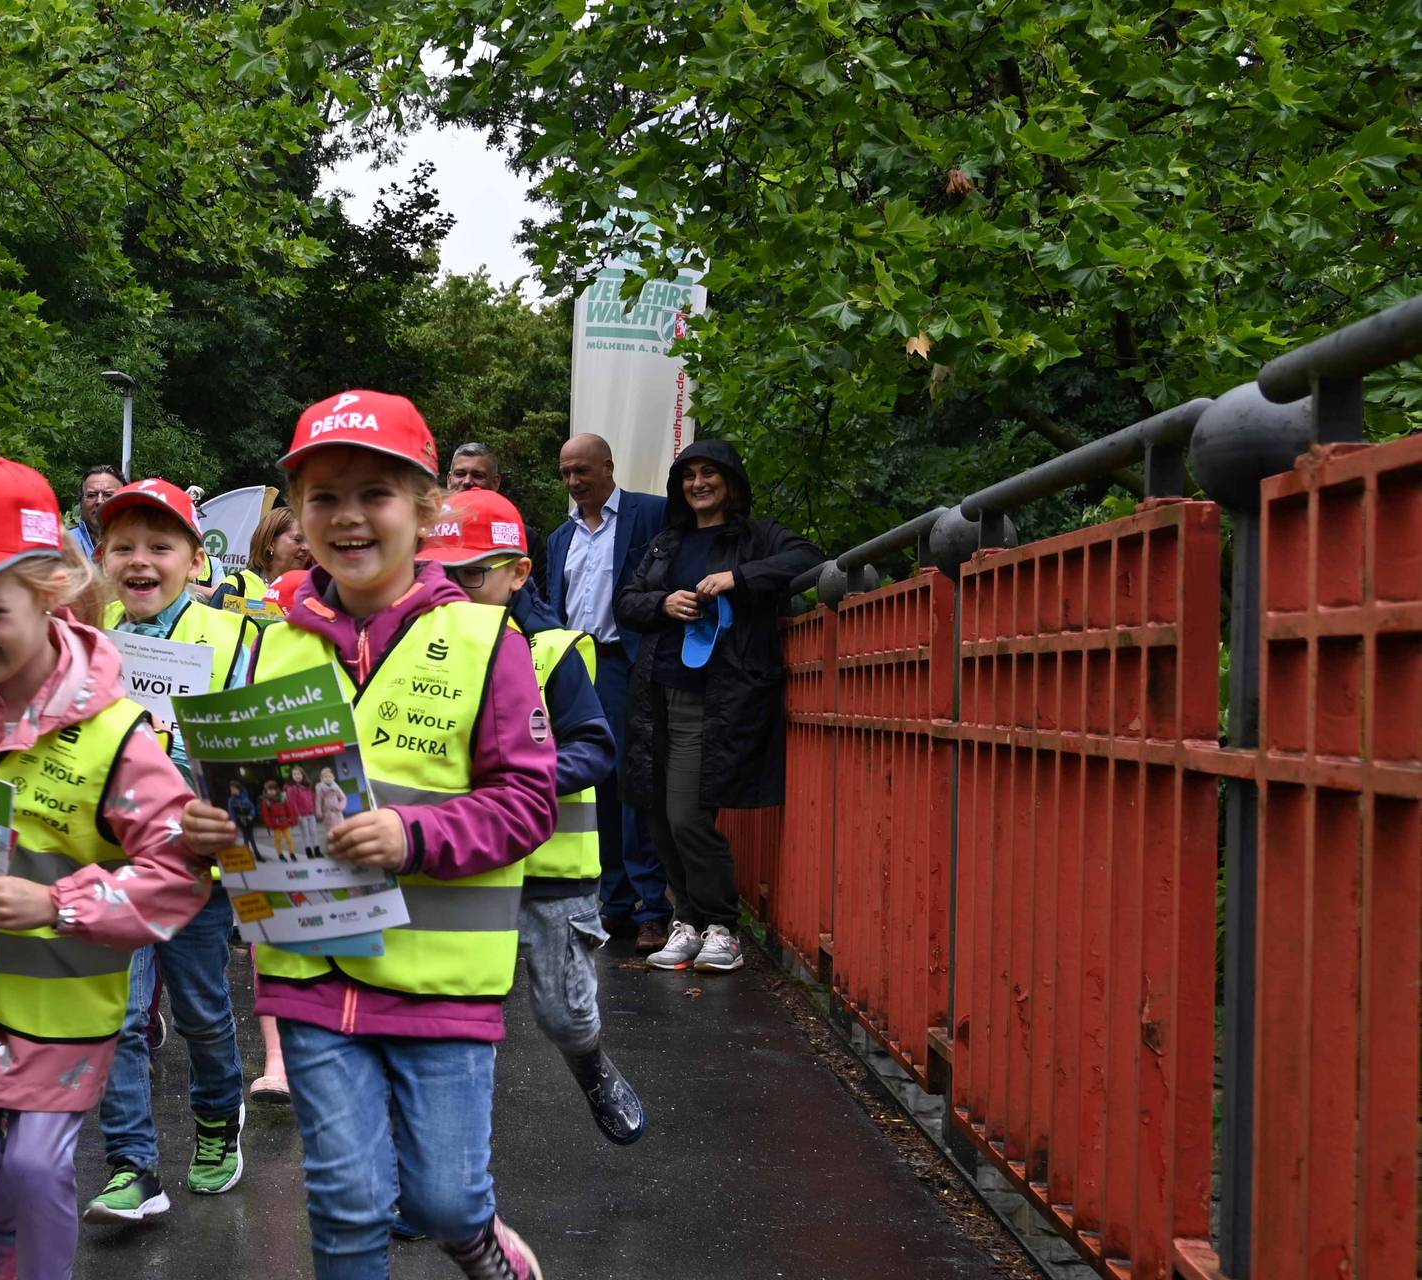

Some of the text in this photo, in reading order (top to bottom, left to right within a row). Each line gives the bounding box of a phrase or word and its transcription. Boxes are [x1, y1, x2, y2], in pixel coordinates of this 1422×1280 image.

[588, 280, 692, 306] VEREHRS
[586, 340, 635, 352] MÜLHEIM
[638, 344, 648, 352] A.
[310, 412, 378, 438] DEKRA
[132, 670, 172, 681] AUTOHAUS
[266, 686, 322, 714] Schule
[412, 681, 462, 700] WOLF
[407, 711, 456, 731] WOLF
[196, 717, 341, 749] Sicher zur Schule
[396, 734, 447, 757] DEKRA
[44, 760, 86, 786] WOLF
[34, 791, 78, 814] WOLF
